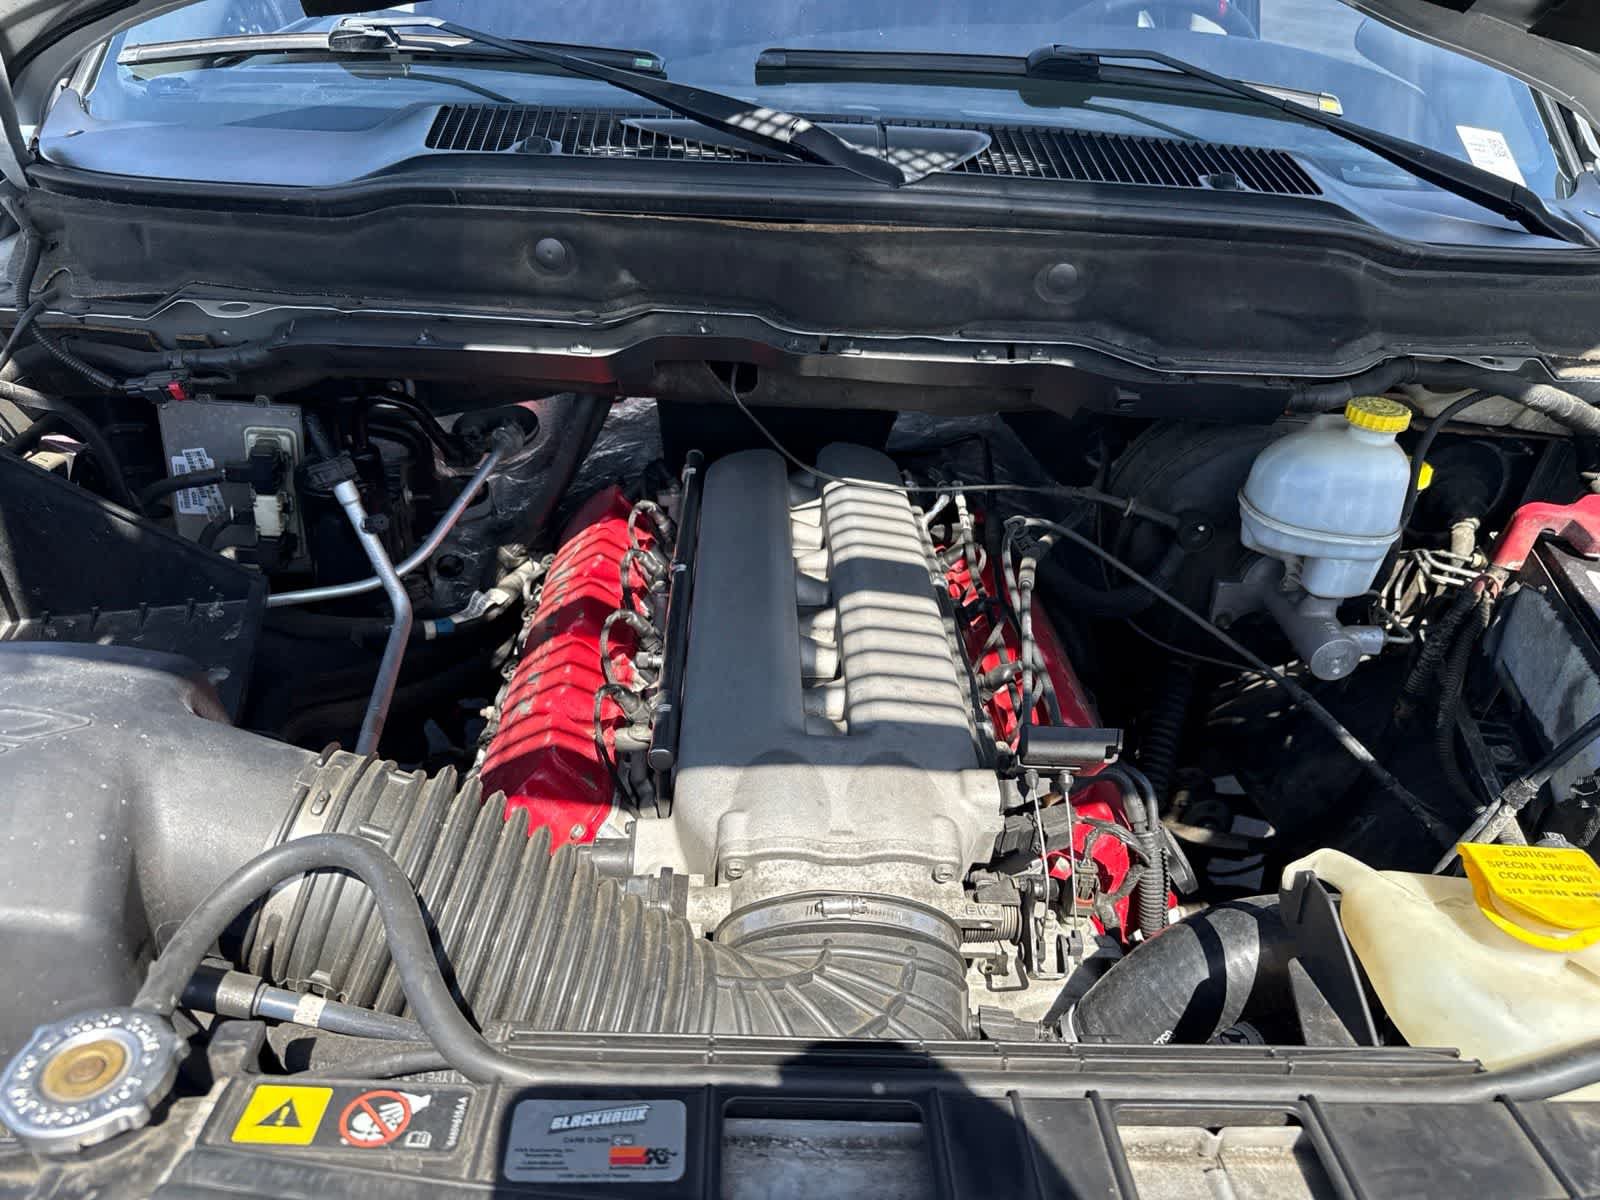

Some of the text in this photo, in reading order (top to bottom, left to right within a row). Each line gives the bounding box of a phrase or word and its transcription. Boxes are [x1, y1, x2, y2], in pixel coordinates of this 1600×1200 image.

[1487, 860, 1587, 871] SPECIAL ENGINE
[1498, 871, 1593, 883] COOLANT ONLY
[550, 1108, 650, 1131] BLACKHAWK
